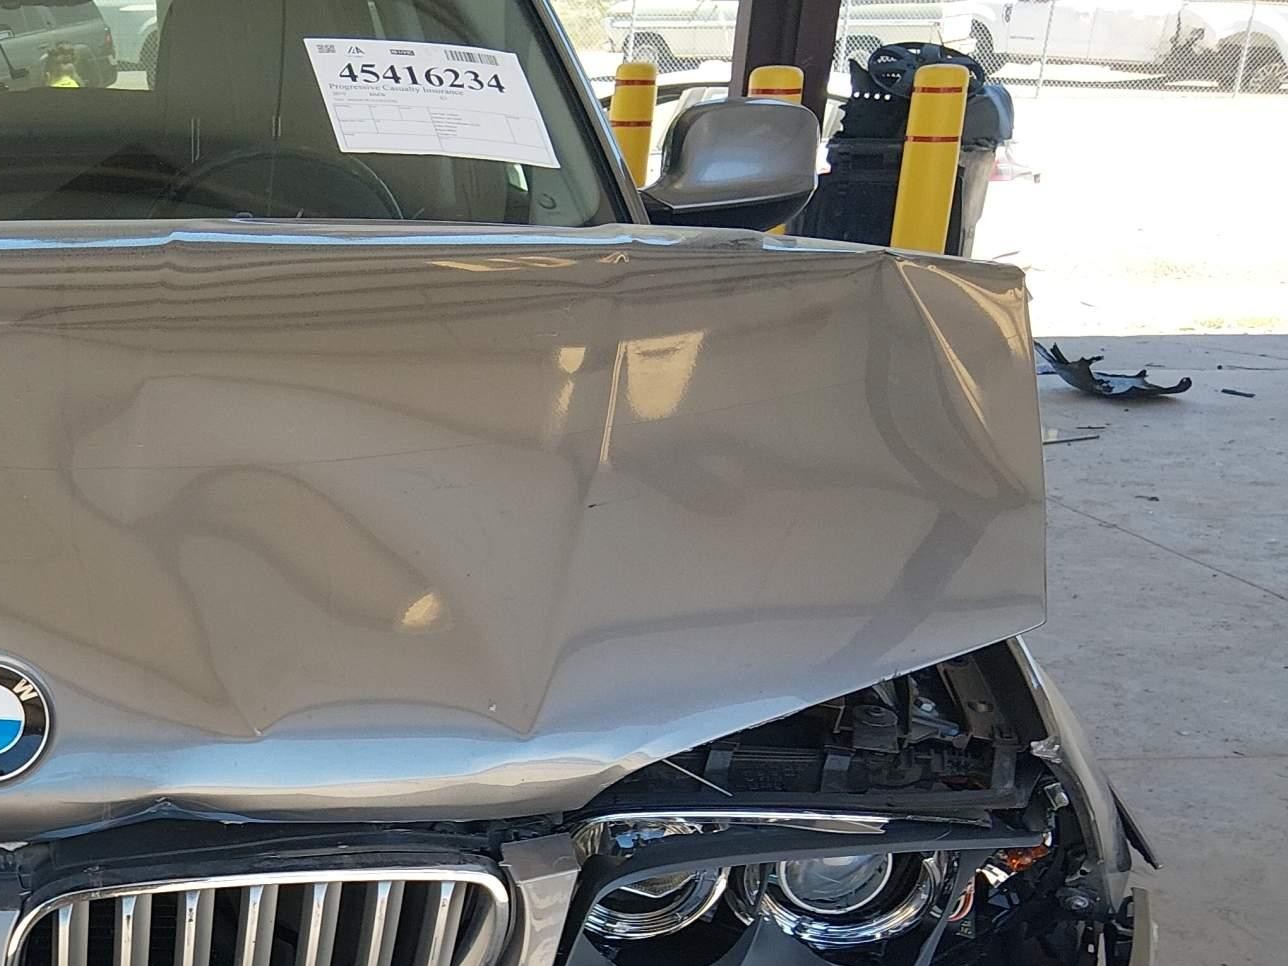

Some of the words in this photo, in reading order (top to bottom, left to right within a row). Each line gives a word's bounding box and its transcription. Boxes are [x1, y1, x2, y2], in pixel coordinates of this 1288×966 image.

[339, 62, 506, 94] 45416234
[329, 83, 381, 92] Progressive
[382, 84, 420, 94] Casualty
[423, 86, 465, 96] Insurance
